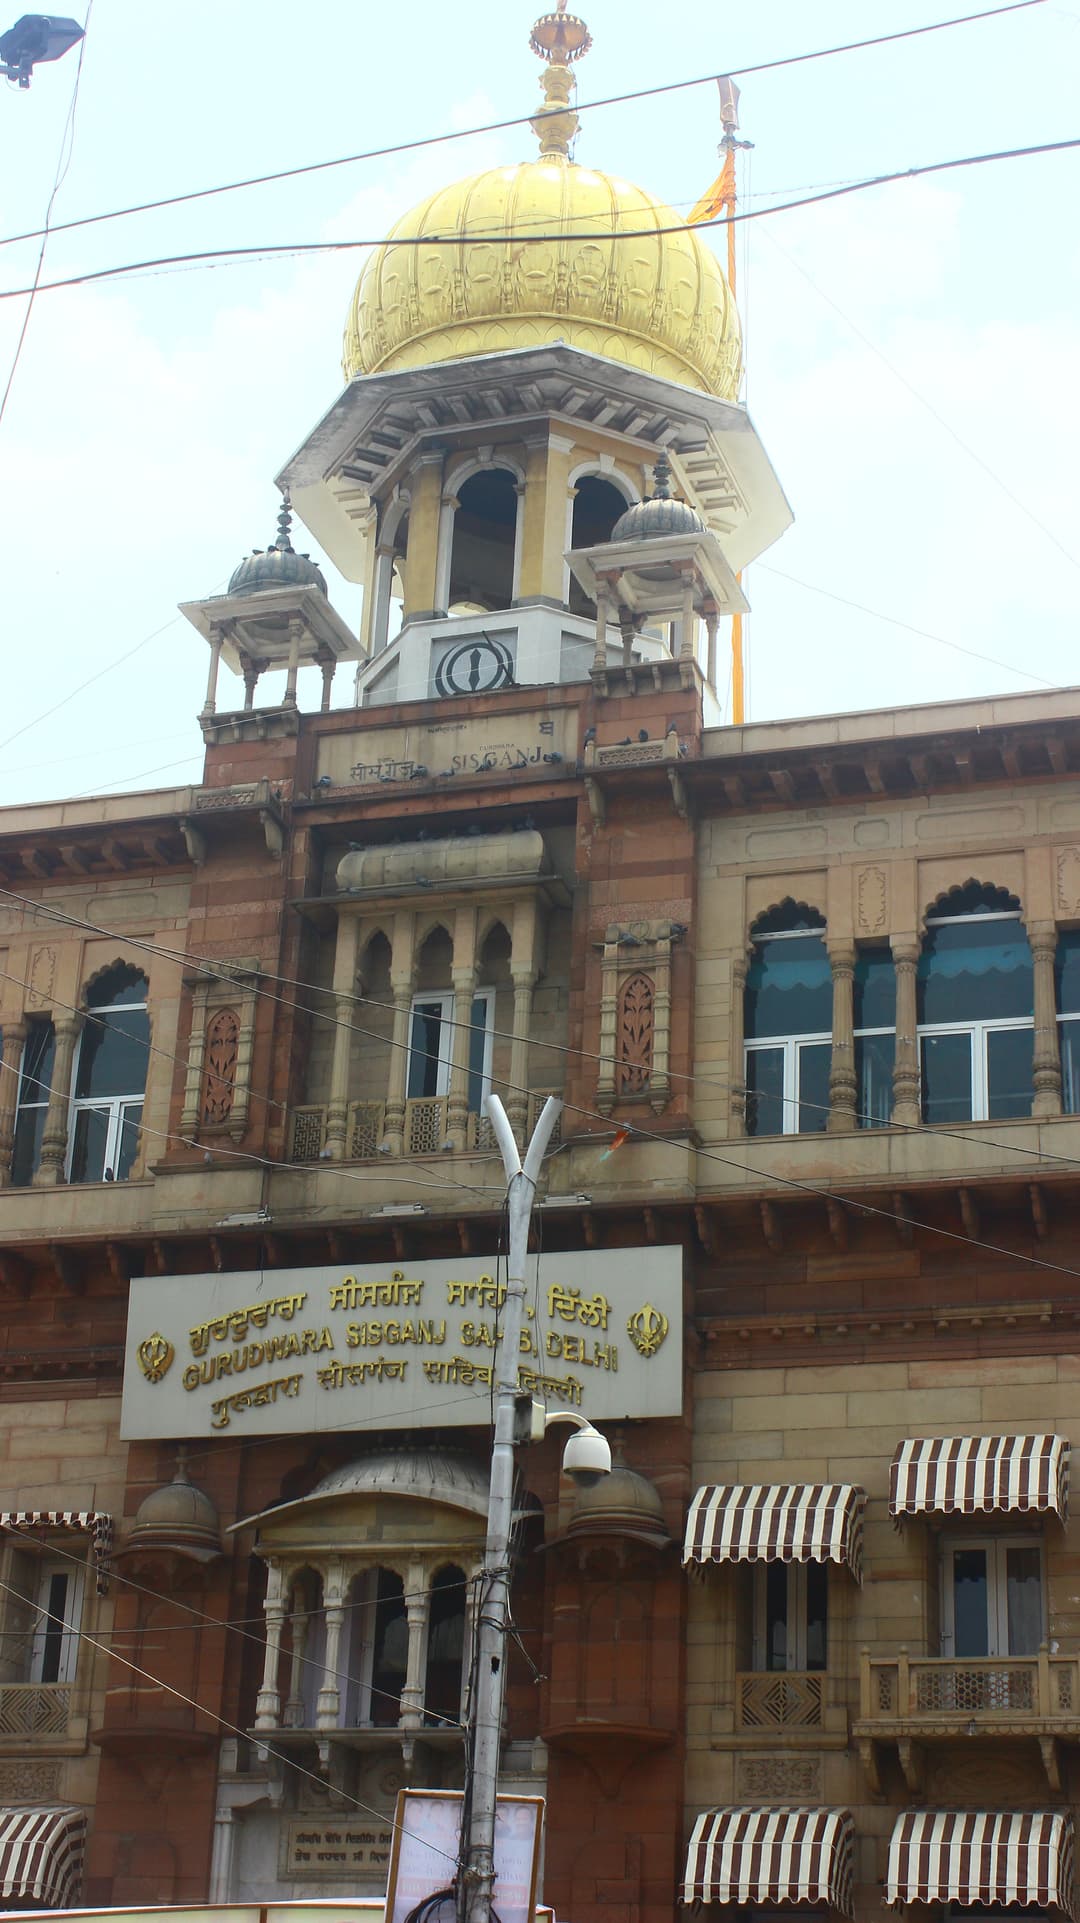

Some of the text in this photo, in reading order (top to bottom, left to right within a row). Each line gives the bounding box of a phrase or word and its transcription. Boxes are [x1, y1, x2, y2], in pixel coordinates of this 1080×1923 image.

[452, 746, 542, 770] SISGANJ
[182, 1326, 334, 1392] GURUDWARA
[345, 1318, 446, 1347] SISGANJ
[546, 1331, 618, 1372] DELHI
[316, 1355, 408, 1391] सीसगंज
